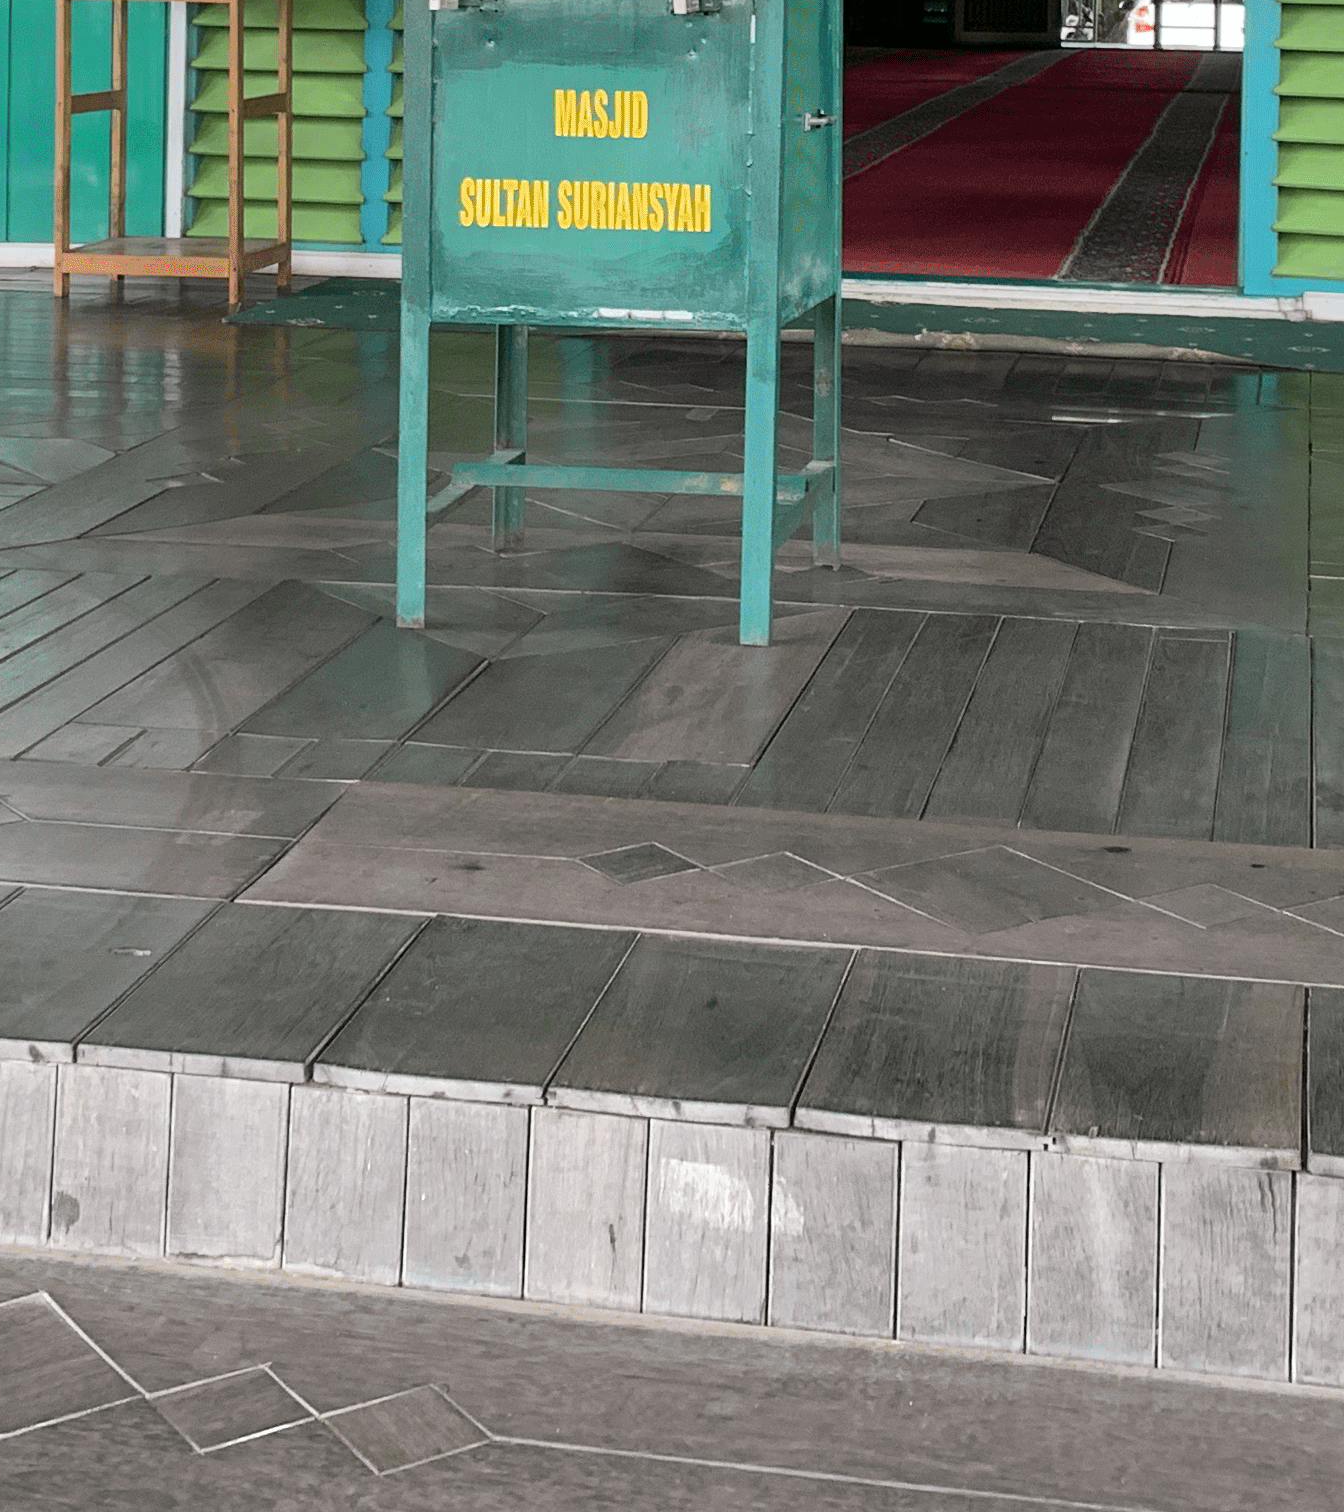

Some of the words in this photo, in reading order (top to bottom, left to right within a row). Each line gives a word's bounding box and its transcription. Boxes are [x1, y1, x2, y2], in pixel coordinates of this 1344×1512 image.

[554, 89, 649, 138] MASJID
[459, 176, 549, 228] SULTAN
[557, 180, 711, 232] SURIANSYAH
